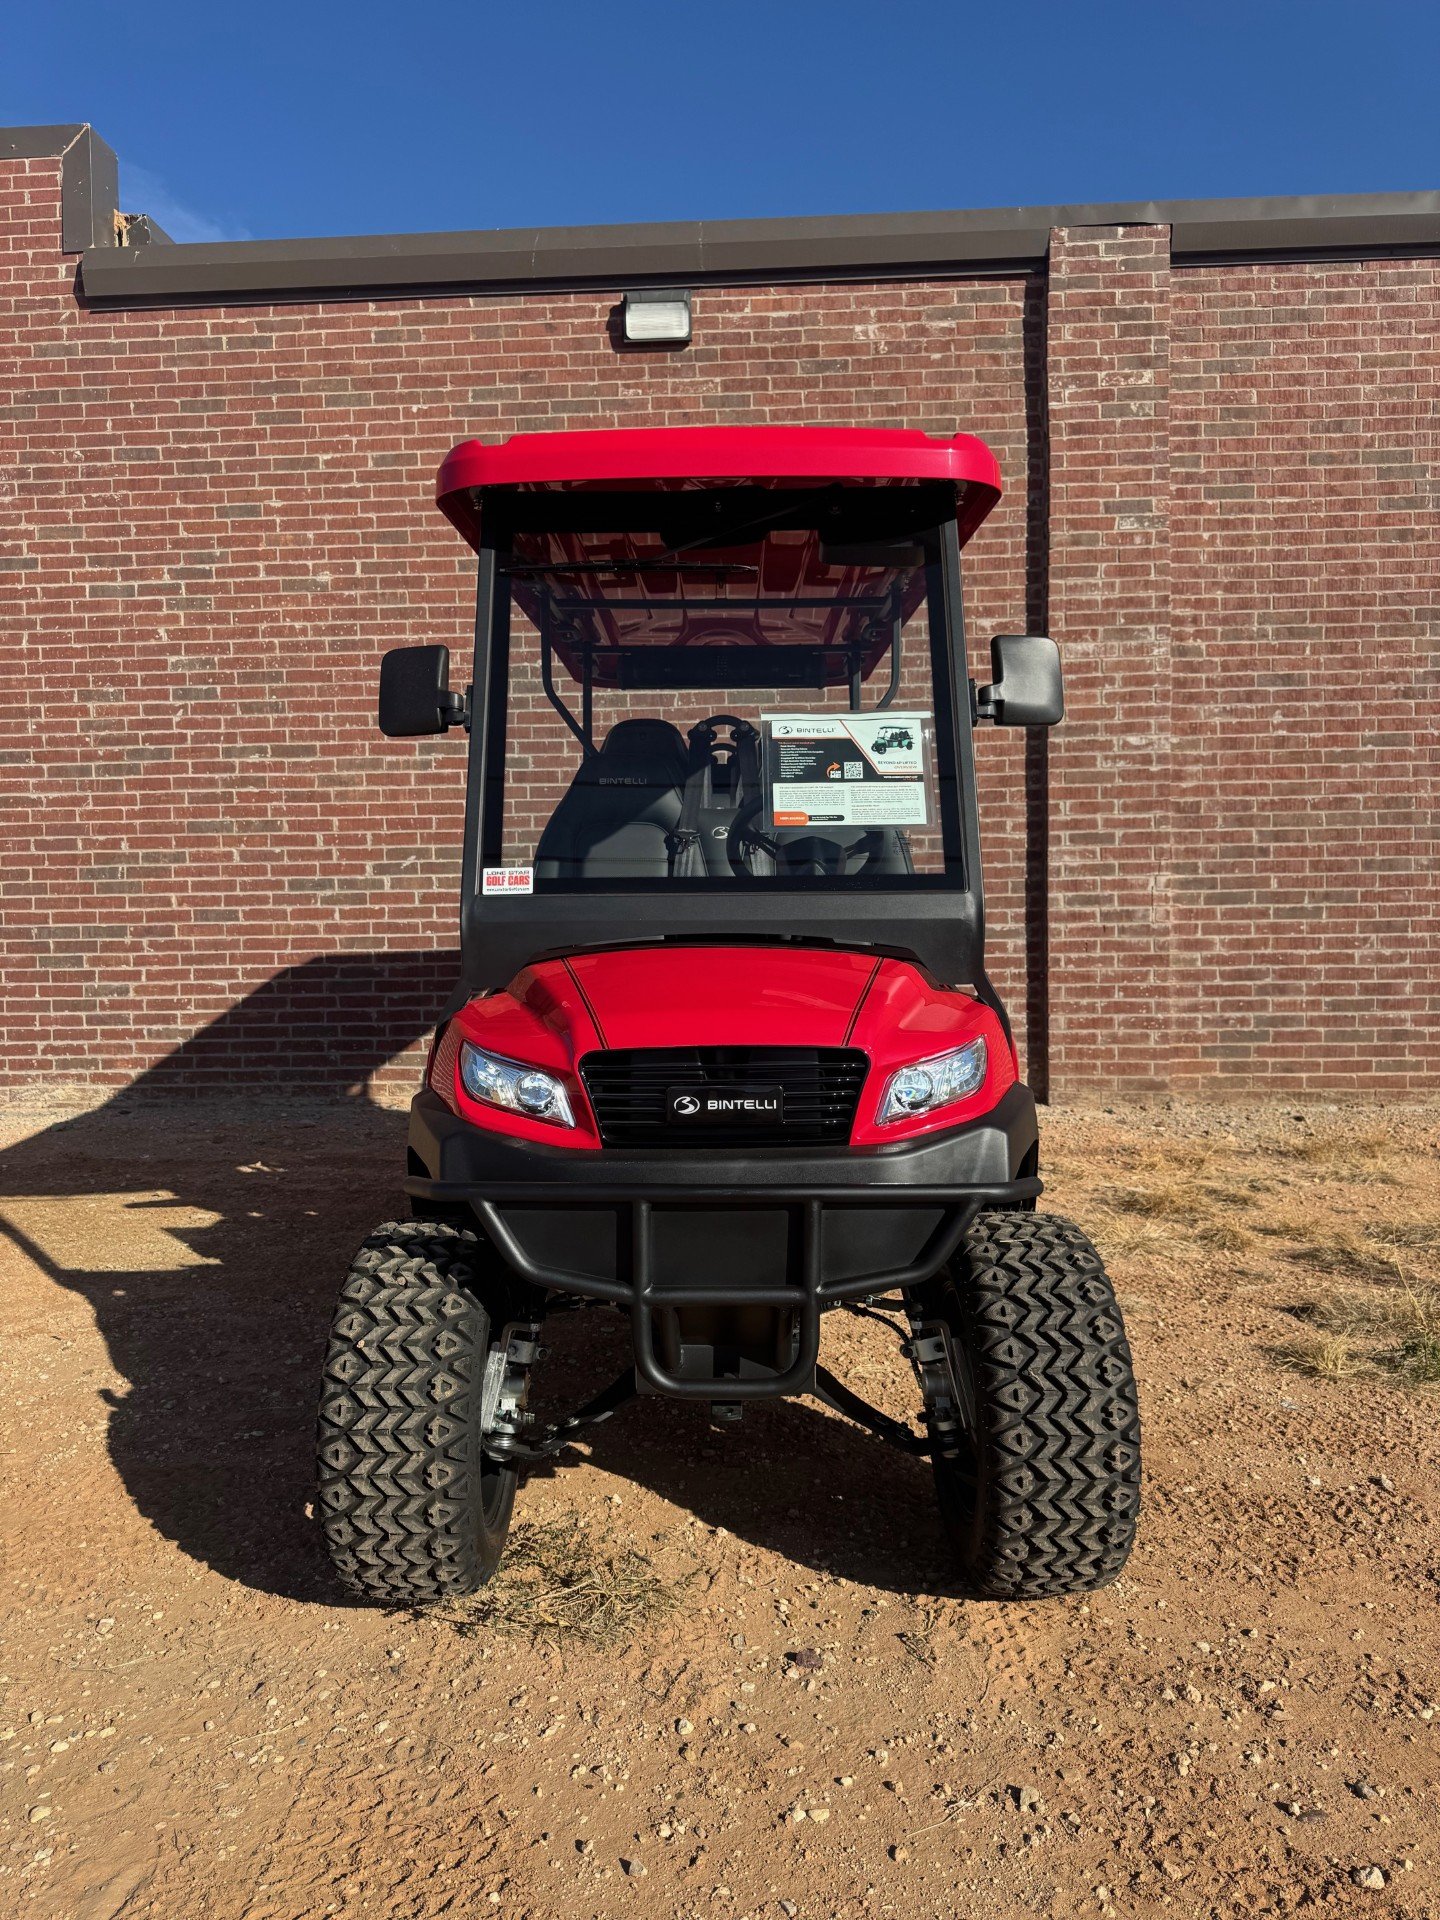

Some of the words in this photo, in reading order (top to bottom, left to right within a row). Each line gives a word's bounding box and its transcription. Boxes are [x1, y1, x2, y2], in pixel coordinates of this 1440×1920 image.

[599, 777, 647, 785] BINTELLI
[486, 875, 506, 886] GOLF
[508, 875, 530, 886] CARS
[707, 1099, 777, 1110] BINTELLI
